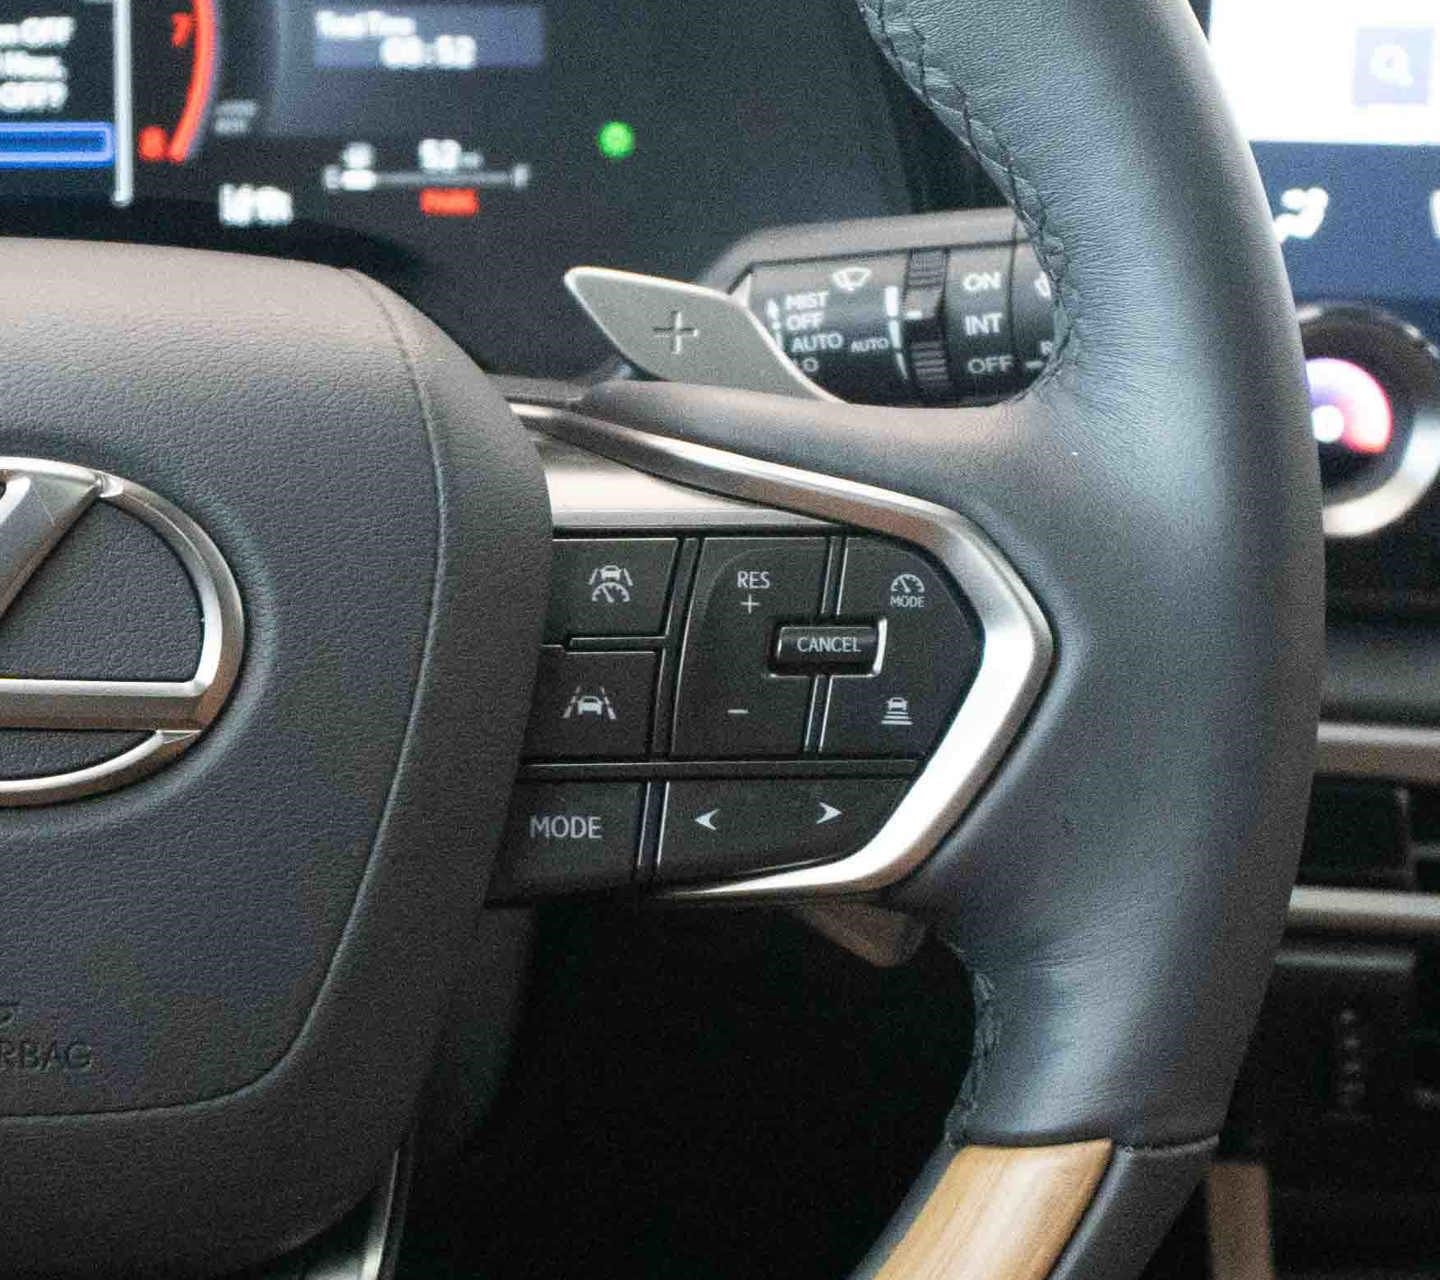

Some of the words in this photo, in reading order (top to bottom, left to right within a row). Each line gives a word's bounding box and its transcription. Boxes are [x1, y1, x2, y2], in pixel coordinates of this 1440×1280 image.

[172, 11, 193, 48] 7
[962, 272, 1002, 292] ON
[785, 291, 830, 310] MIST
[786, 311, 824, 332] OFF
[964, 312, 1003, 336] INT
[790, 332, 844, 352] AUTO
[850, 337, 890, 354] AUTO
[967, 355, 1013, 374] OFF
[736, 571, 770, 590] RES
[889, 593, 926, 609] MODE
[796, 636, 862, 654] CANCEL
[530, 815, 603, 840] MODE
